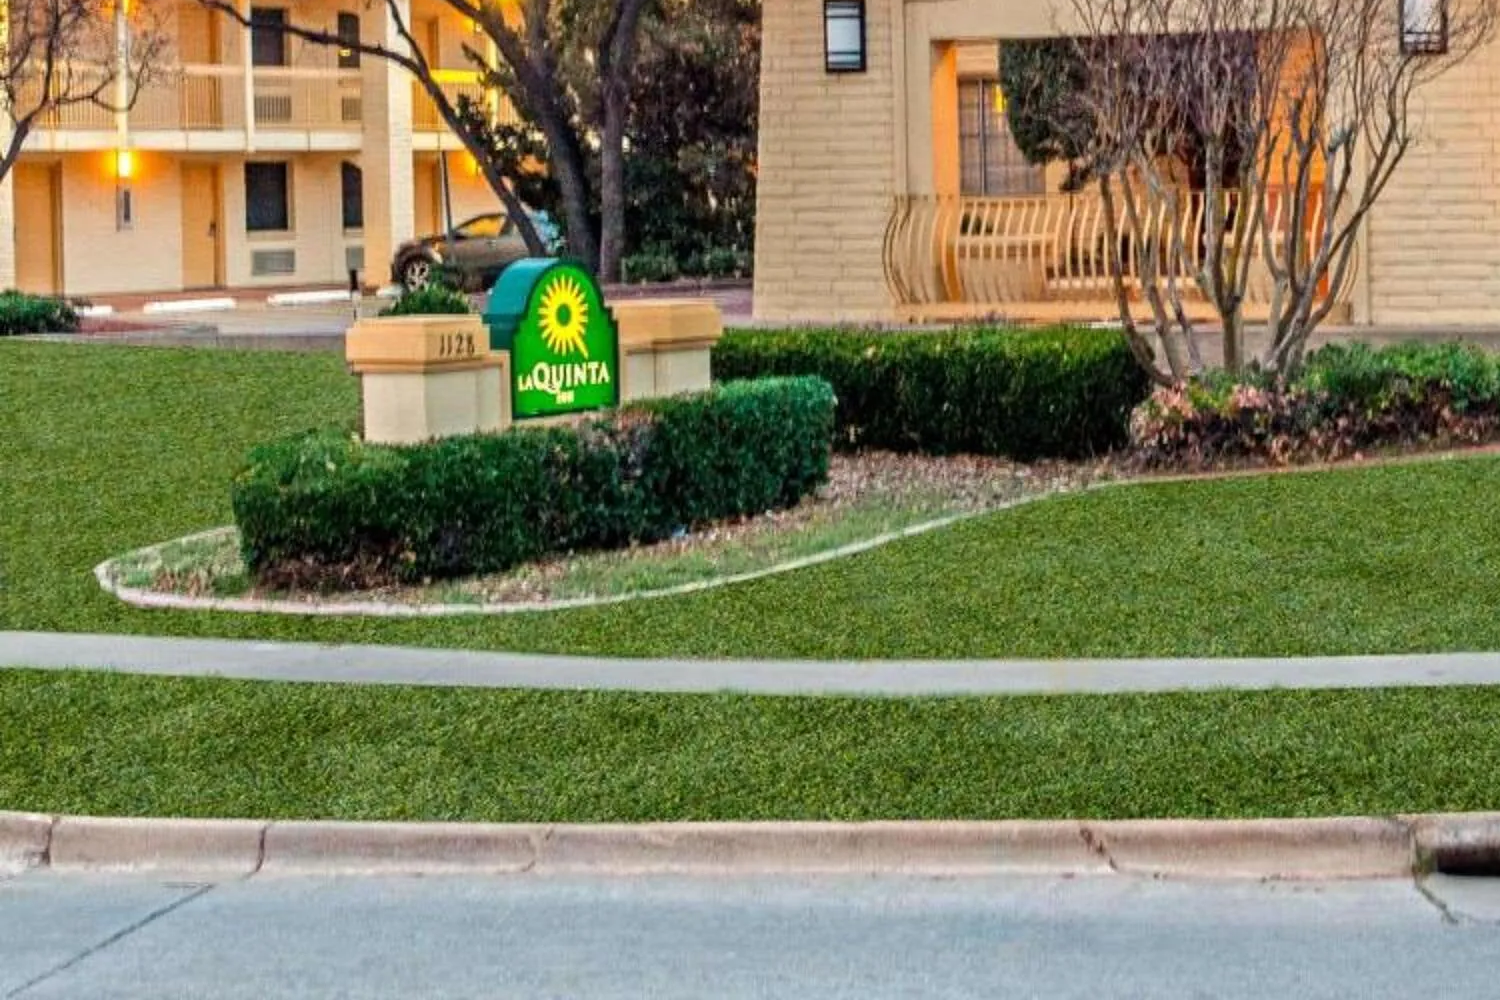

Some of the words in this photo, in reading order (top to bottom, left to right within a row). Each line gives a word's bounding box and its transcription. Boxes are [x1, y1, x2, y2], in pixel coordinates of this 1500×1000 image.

[440, 333, 475, 356] 1128
[517, 374, 534, 392] LA
[532, 361, 610, 395] QUINTA
